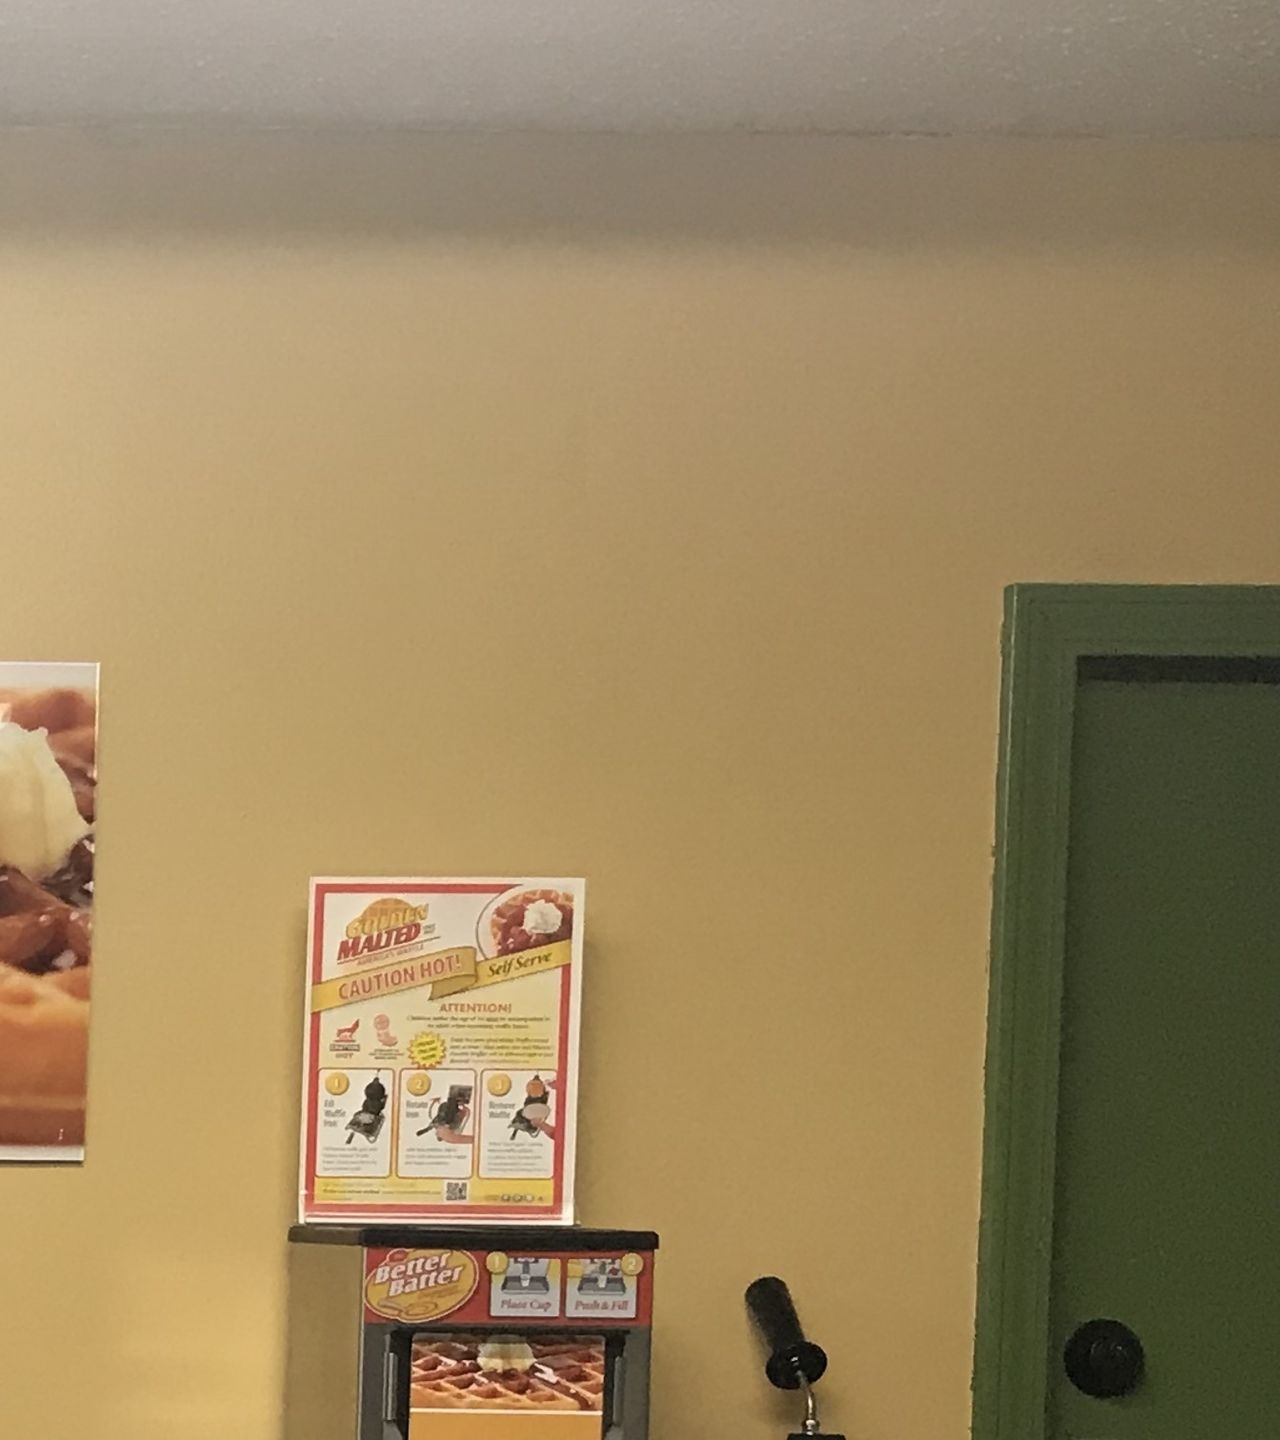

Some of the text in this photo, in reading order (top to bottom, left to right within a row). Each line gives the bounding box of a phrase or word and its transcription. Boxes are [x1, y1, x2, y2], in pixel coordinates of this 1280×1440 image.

[337, 922, 421, 961] MALTED
[338, 955, 461, 1000] CAUTION HOT!
[488, 951, 552, 978] Self Serve
[440, 1003, 512, 1014] ATTENTION!
[375, 1252, 452, 1284] Better
[389, 1266, 463, 1297] Batter
[529, 1300, 552, 1313] Cup
